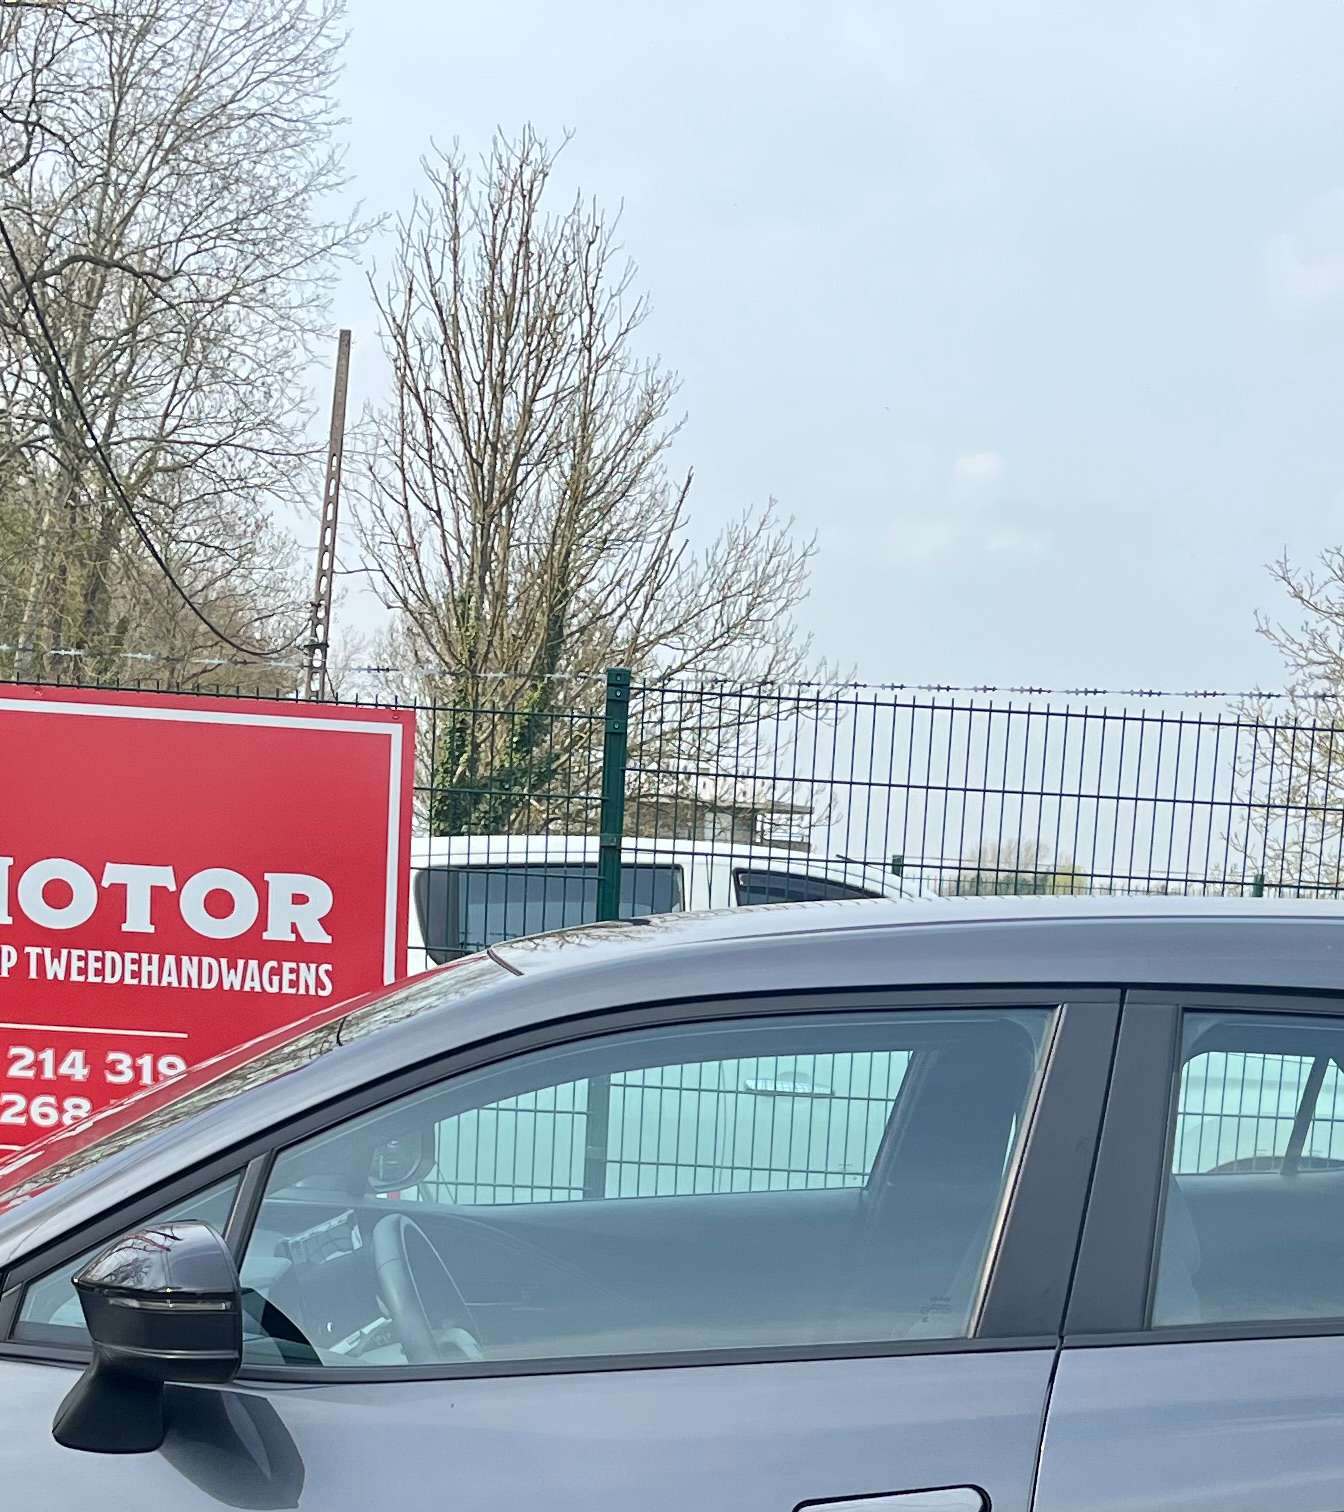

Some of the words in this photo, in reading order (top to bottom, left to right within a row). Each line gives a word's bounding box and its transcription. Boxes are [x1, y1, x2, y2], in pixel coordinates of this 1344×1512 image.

[23, 945, 334, 998] TWEEDEHANDWAGENS
[6, 1046, 90, 1083] 214
[104, 1051, 188, 1086] 319
